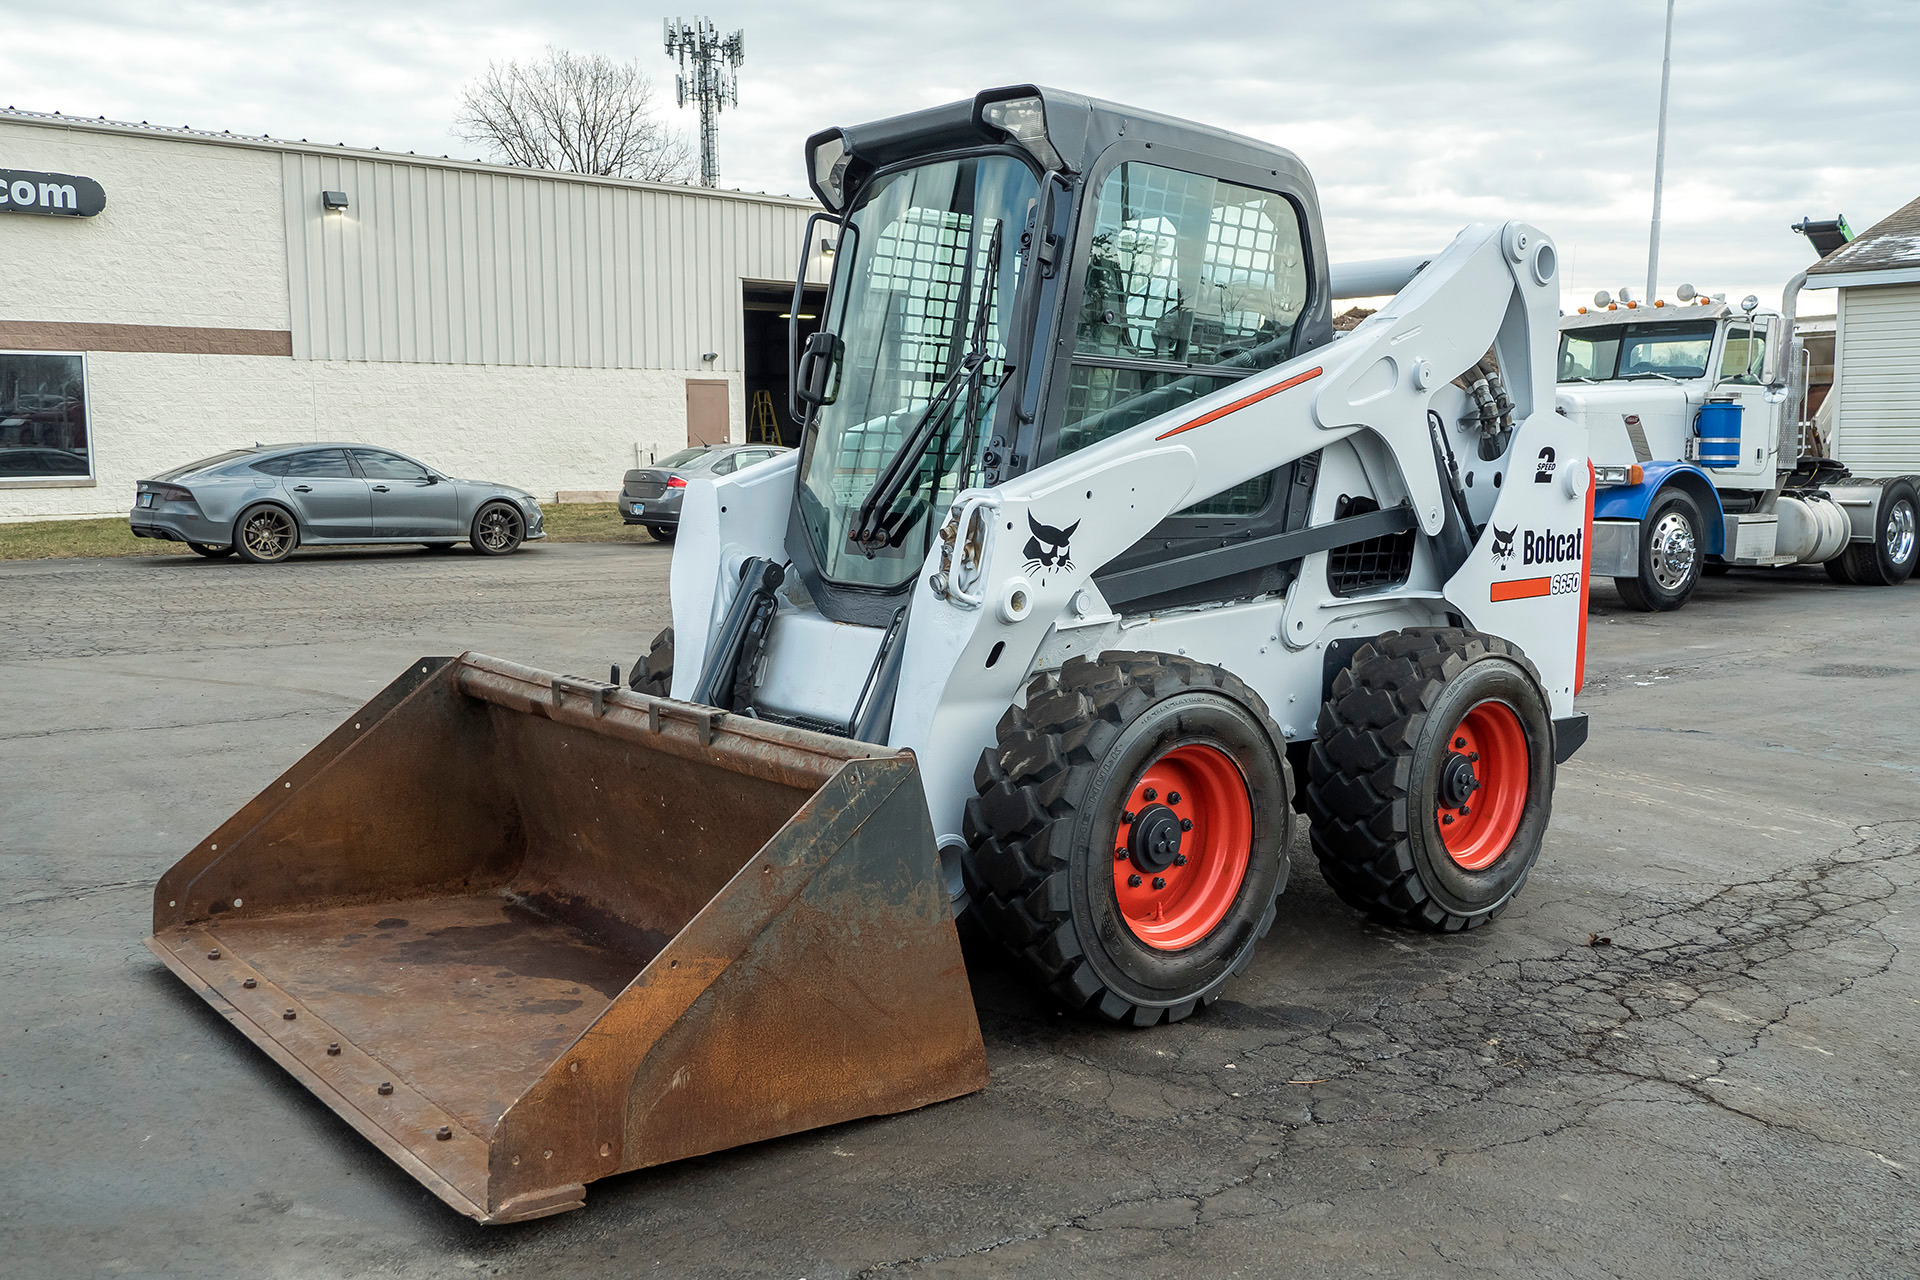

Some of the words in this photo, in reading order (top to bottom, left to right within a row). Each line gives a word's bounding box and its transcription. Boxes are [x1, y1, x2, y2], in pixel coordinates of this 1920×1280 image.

[1534, 446, 1556, 484] 2
[1536, 462, 1557, 471] SPEED
[1523, 528, 1582, 565] Bobcat
[1551, 572, 1581, 595] S650
